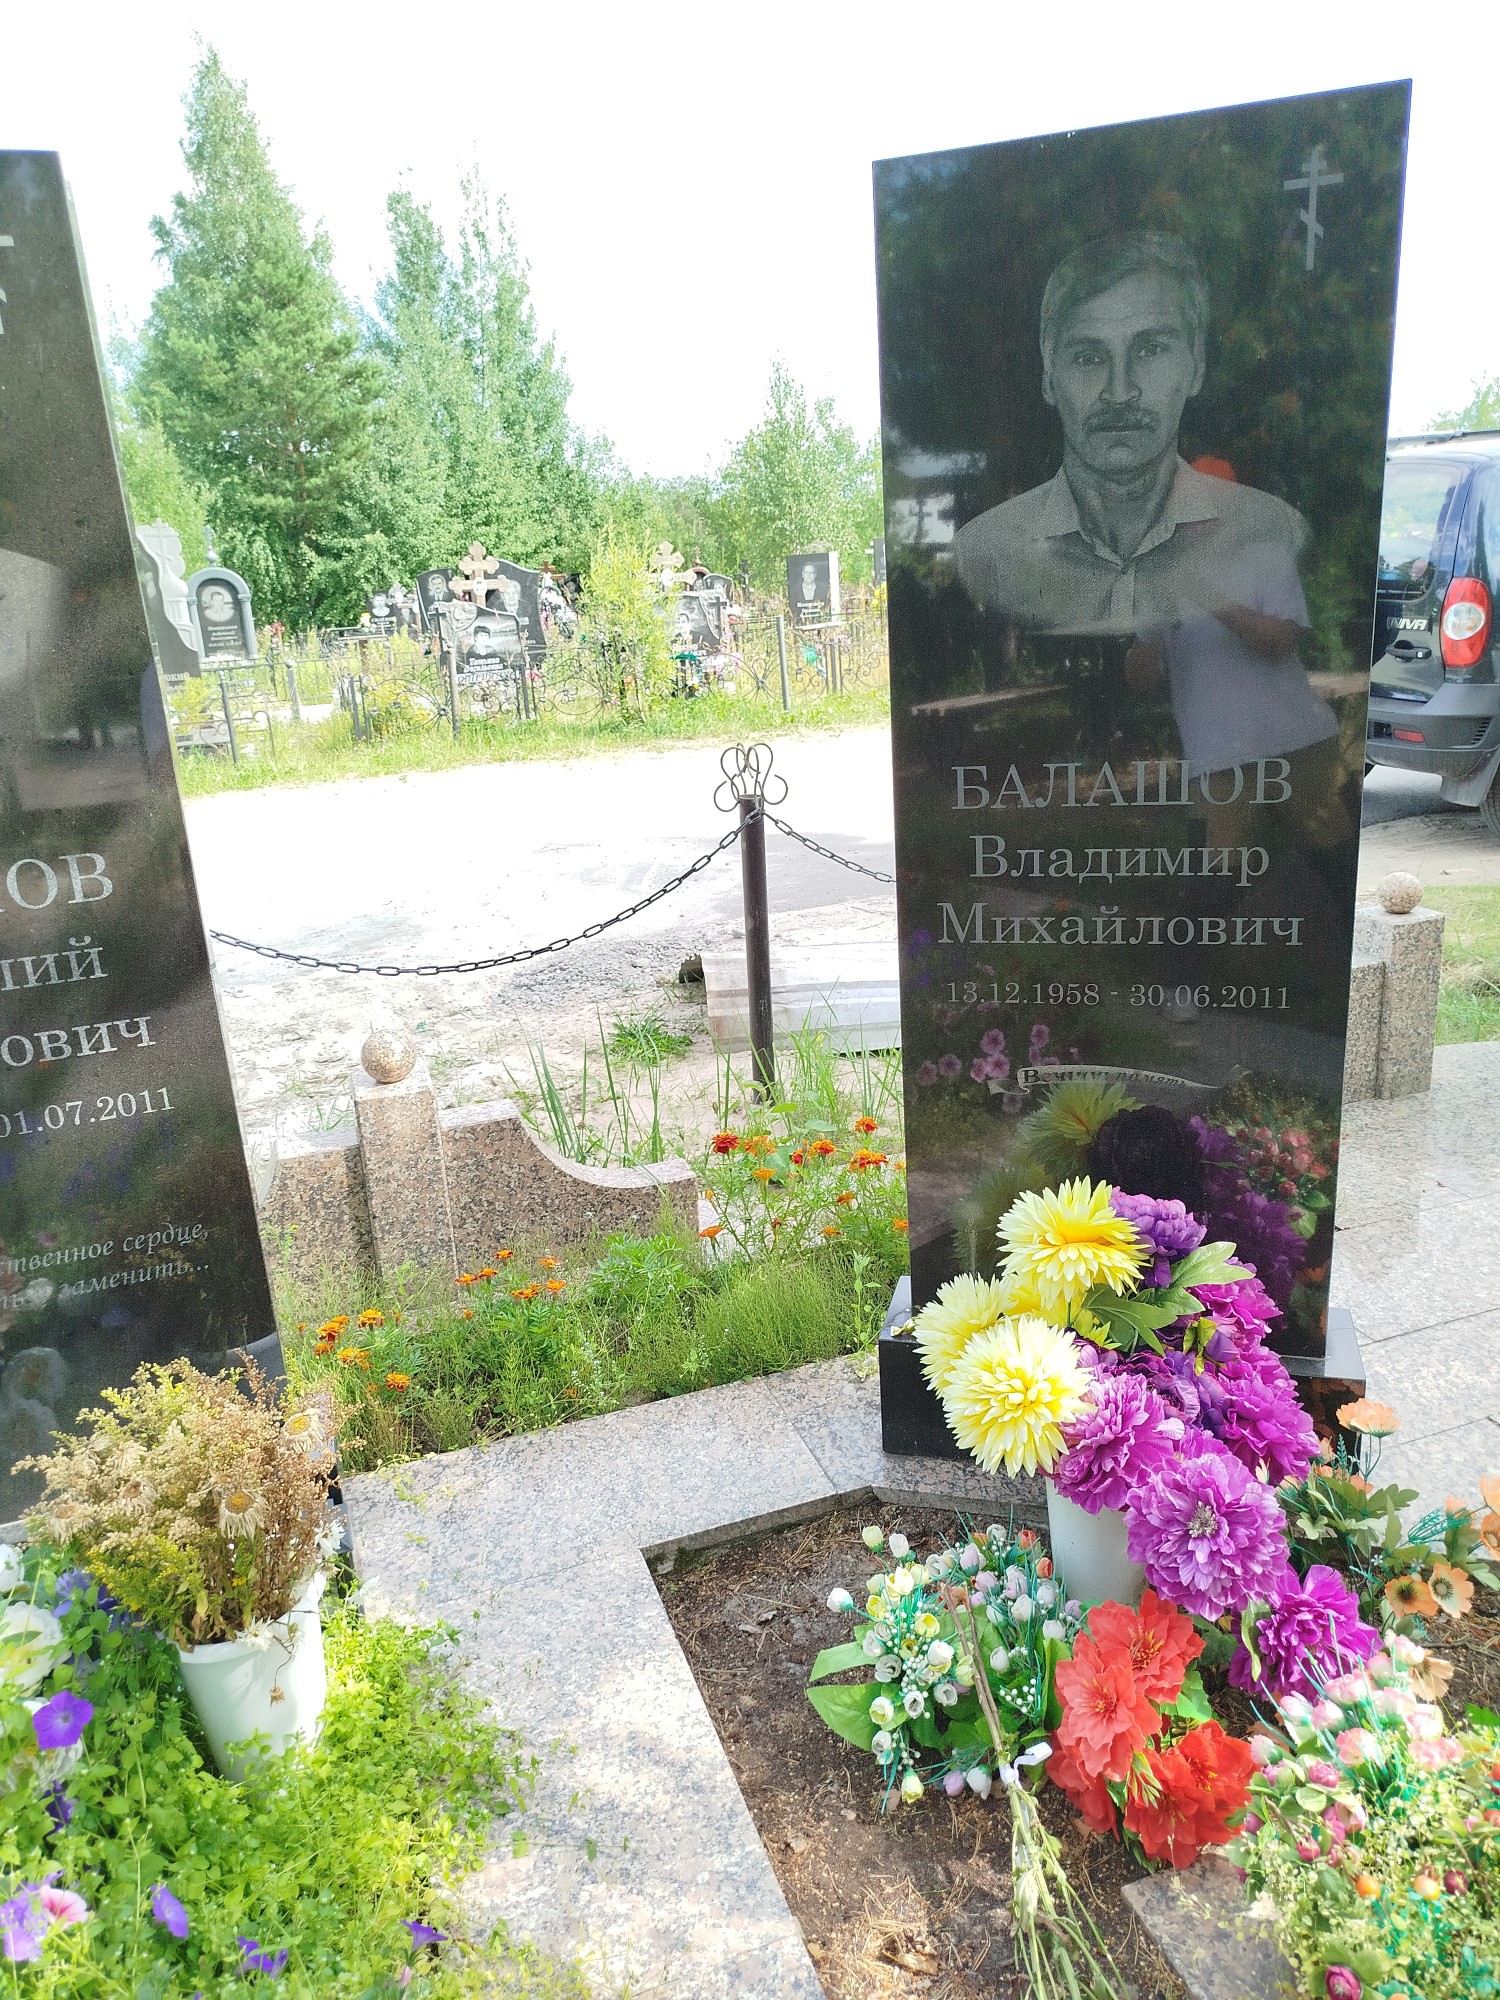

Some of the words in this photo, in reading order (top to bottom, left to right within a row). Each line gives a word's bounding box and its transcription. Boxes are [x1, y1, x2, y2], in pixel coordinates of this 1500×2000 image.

[1386, 617, 1428, 630] NIVA
[951, 758, 1293, 811] БАЛАШОВ
[0, 852, 113, 912] ОВ
[969, 835, 1270, 887] Владимир
[937, 902, 1304, 947] Михайлович
[946, 981, 1100, 1006] 13.12.1958
[1130, 983, 1291, 1010] 30.06.2011
[122, 1222, 208, 1255] сердце,
[58, 1258, 209, 1299] заменить...
